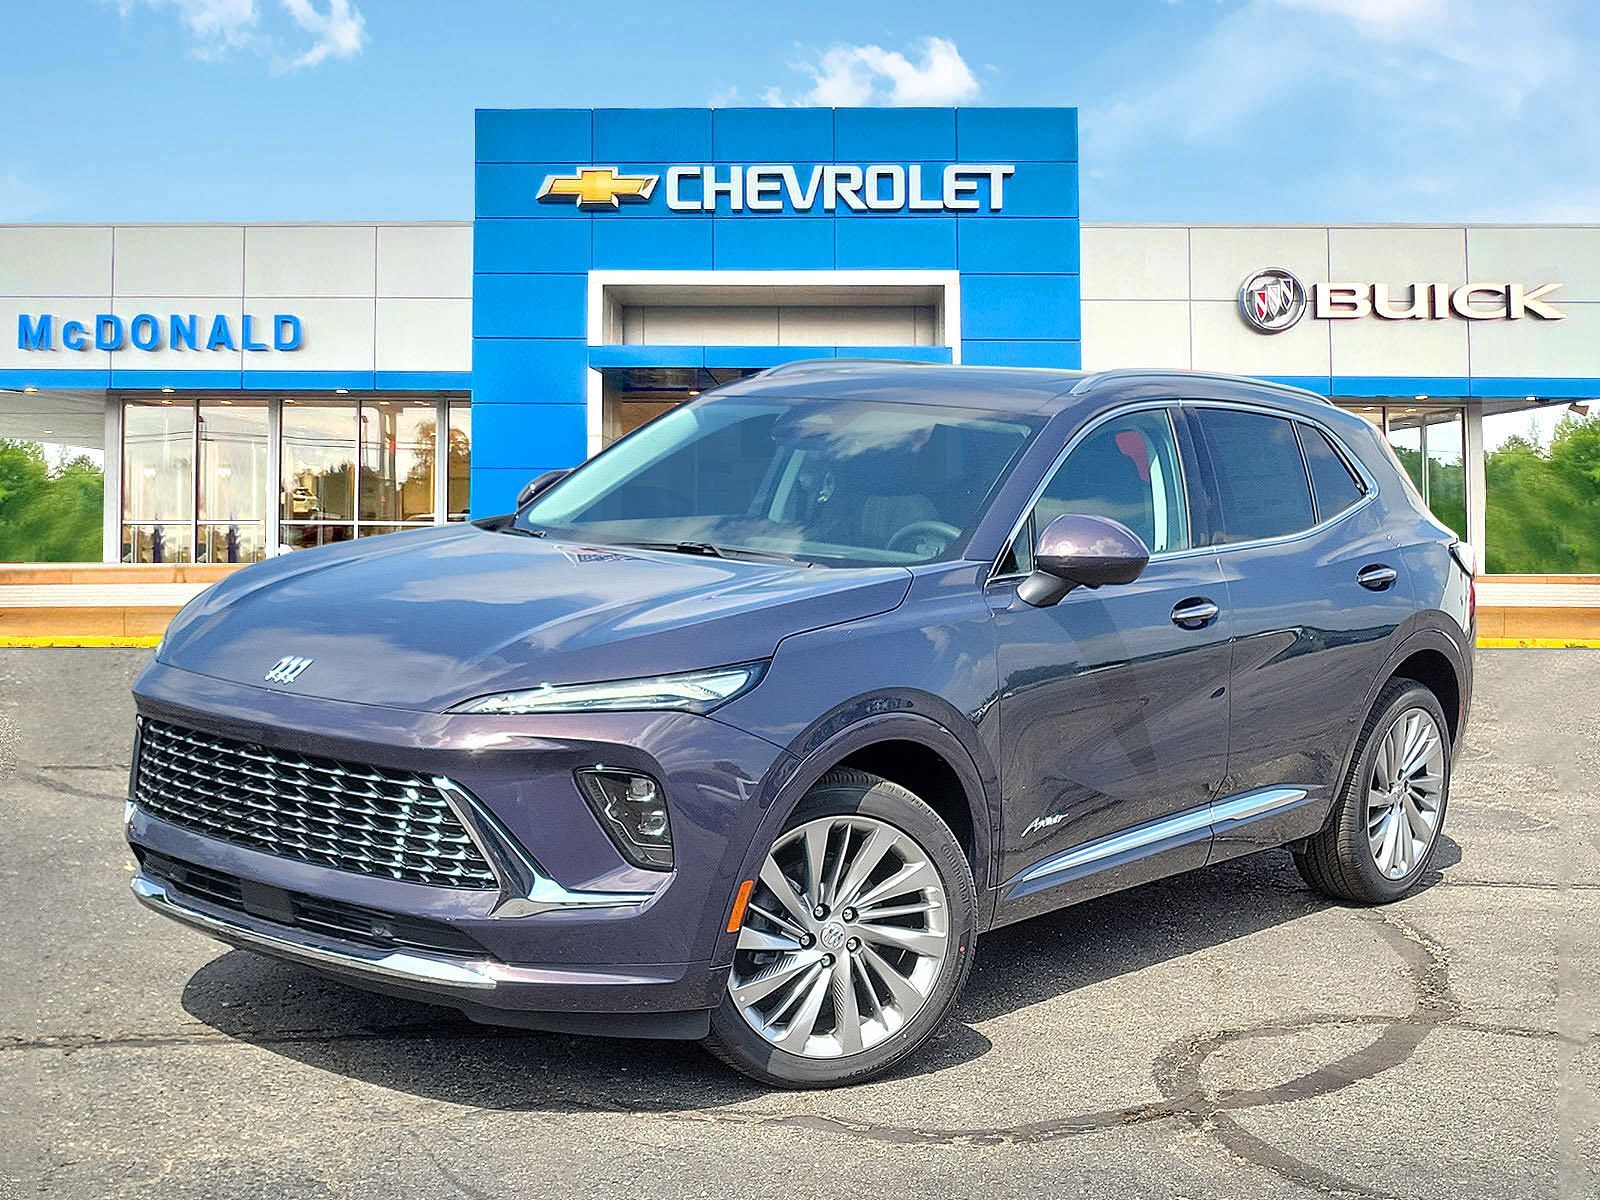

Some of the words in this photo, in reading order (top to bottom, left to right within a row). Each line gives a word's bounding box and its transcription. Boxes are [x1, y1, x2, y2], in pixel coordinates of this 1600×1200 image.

[665, 164, 1015, 212] CHEVROLET
[1312, 281, 1567, 321] BUICK
[17, 313, 304, 351] McDONALD
